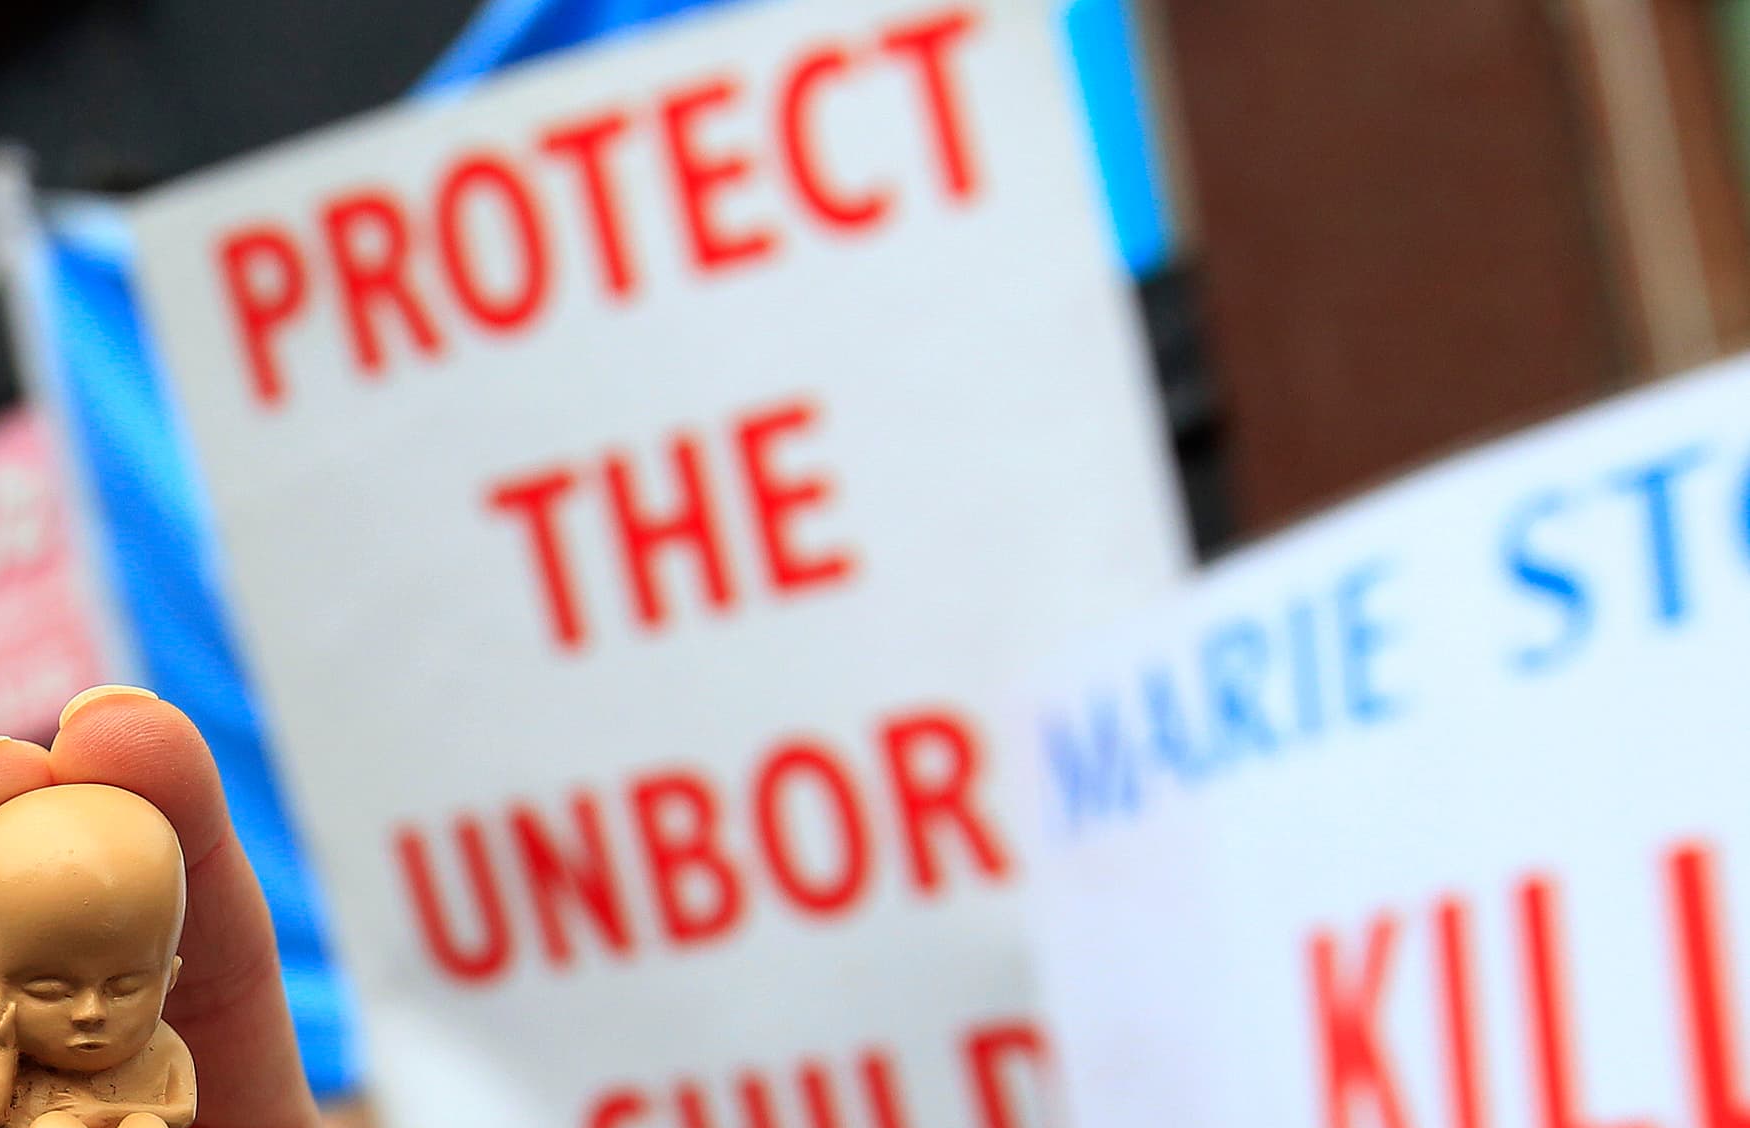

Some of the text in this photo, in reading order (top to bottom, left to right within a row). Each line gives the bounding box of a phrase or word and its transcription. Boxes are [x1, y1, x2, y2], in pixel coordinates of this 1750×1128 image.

[216, 8, 982, 406] PROTECT
[488, 398, 862, 654] THE
[1038, 440, 1750, 844] MARIE ST
